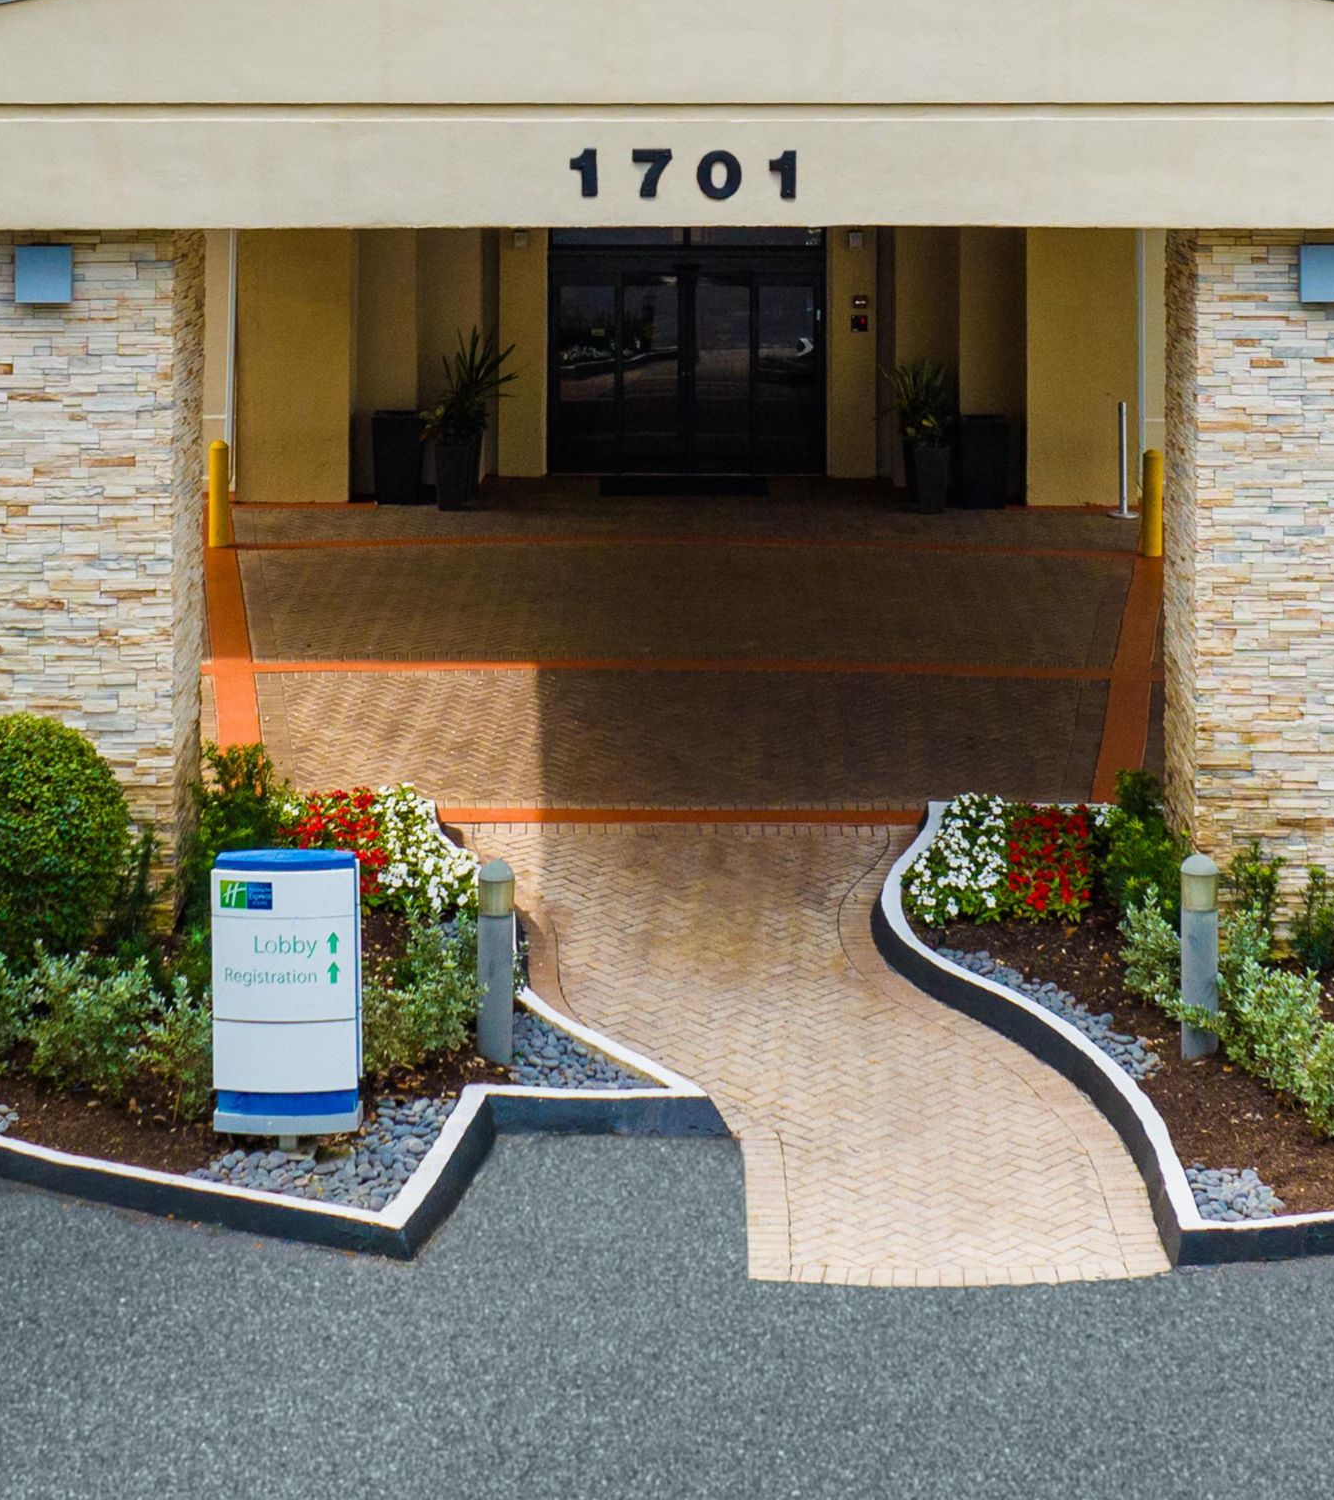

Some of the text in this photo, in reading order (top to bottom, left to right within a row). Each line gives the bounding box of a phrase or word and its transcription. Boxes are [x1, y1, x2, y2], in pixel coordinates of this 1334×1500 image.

[569, 147, 797, 201] 1701
[254, 934, 317, 959] Lobby
[224, 966, 317, 988] Registration
